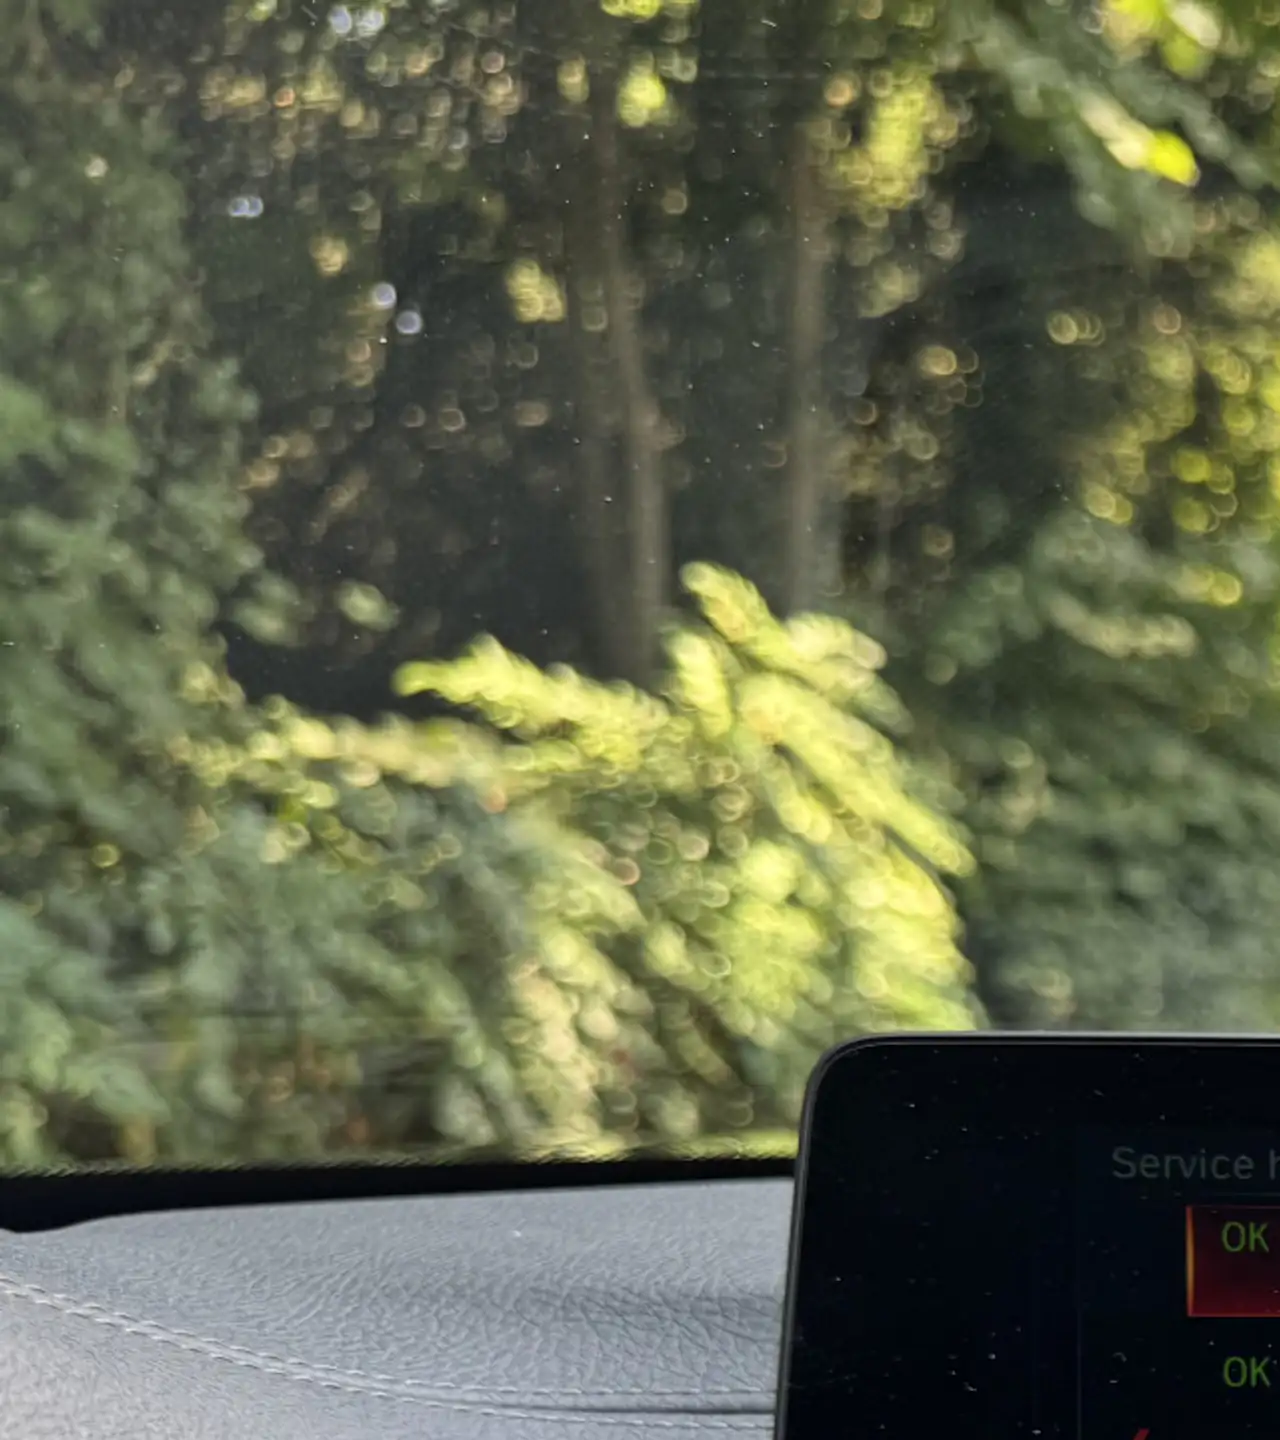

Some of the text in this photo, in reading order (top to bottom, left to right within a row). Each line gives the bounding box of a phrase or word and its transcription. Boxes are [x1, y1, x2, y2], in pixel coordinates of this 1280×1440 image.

[1111, 1145, 1255, 1180] Service
[1221, 1221, 1270, 1253] OK
[1222, 1355, 1271, 1388] OK
